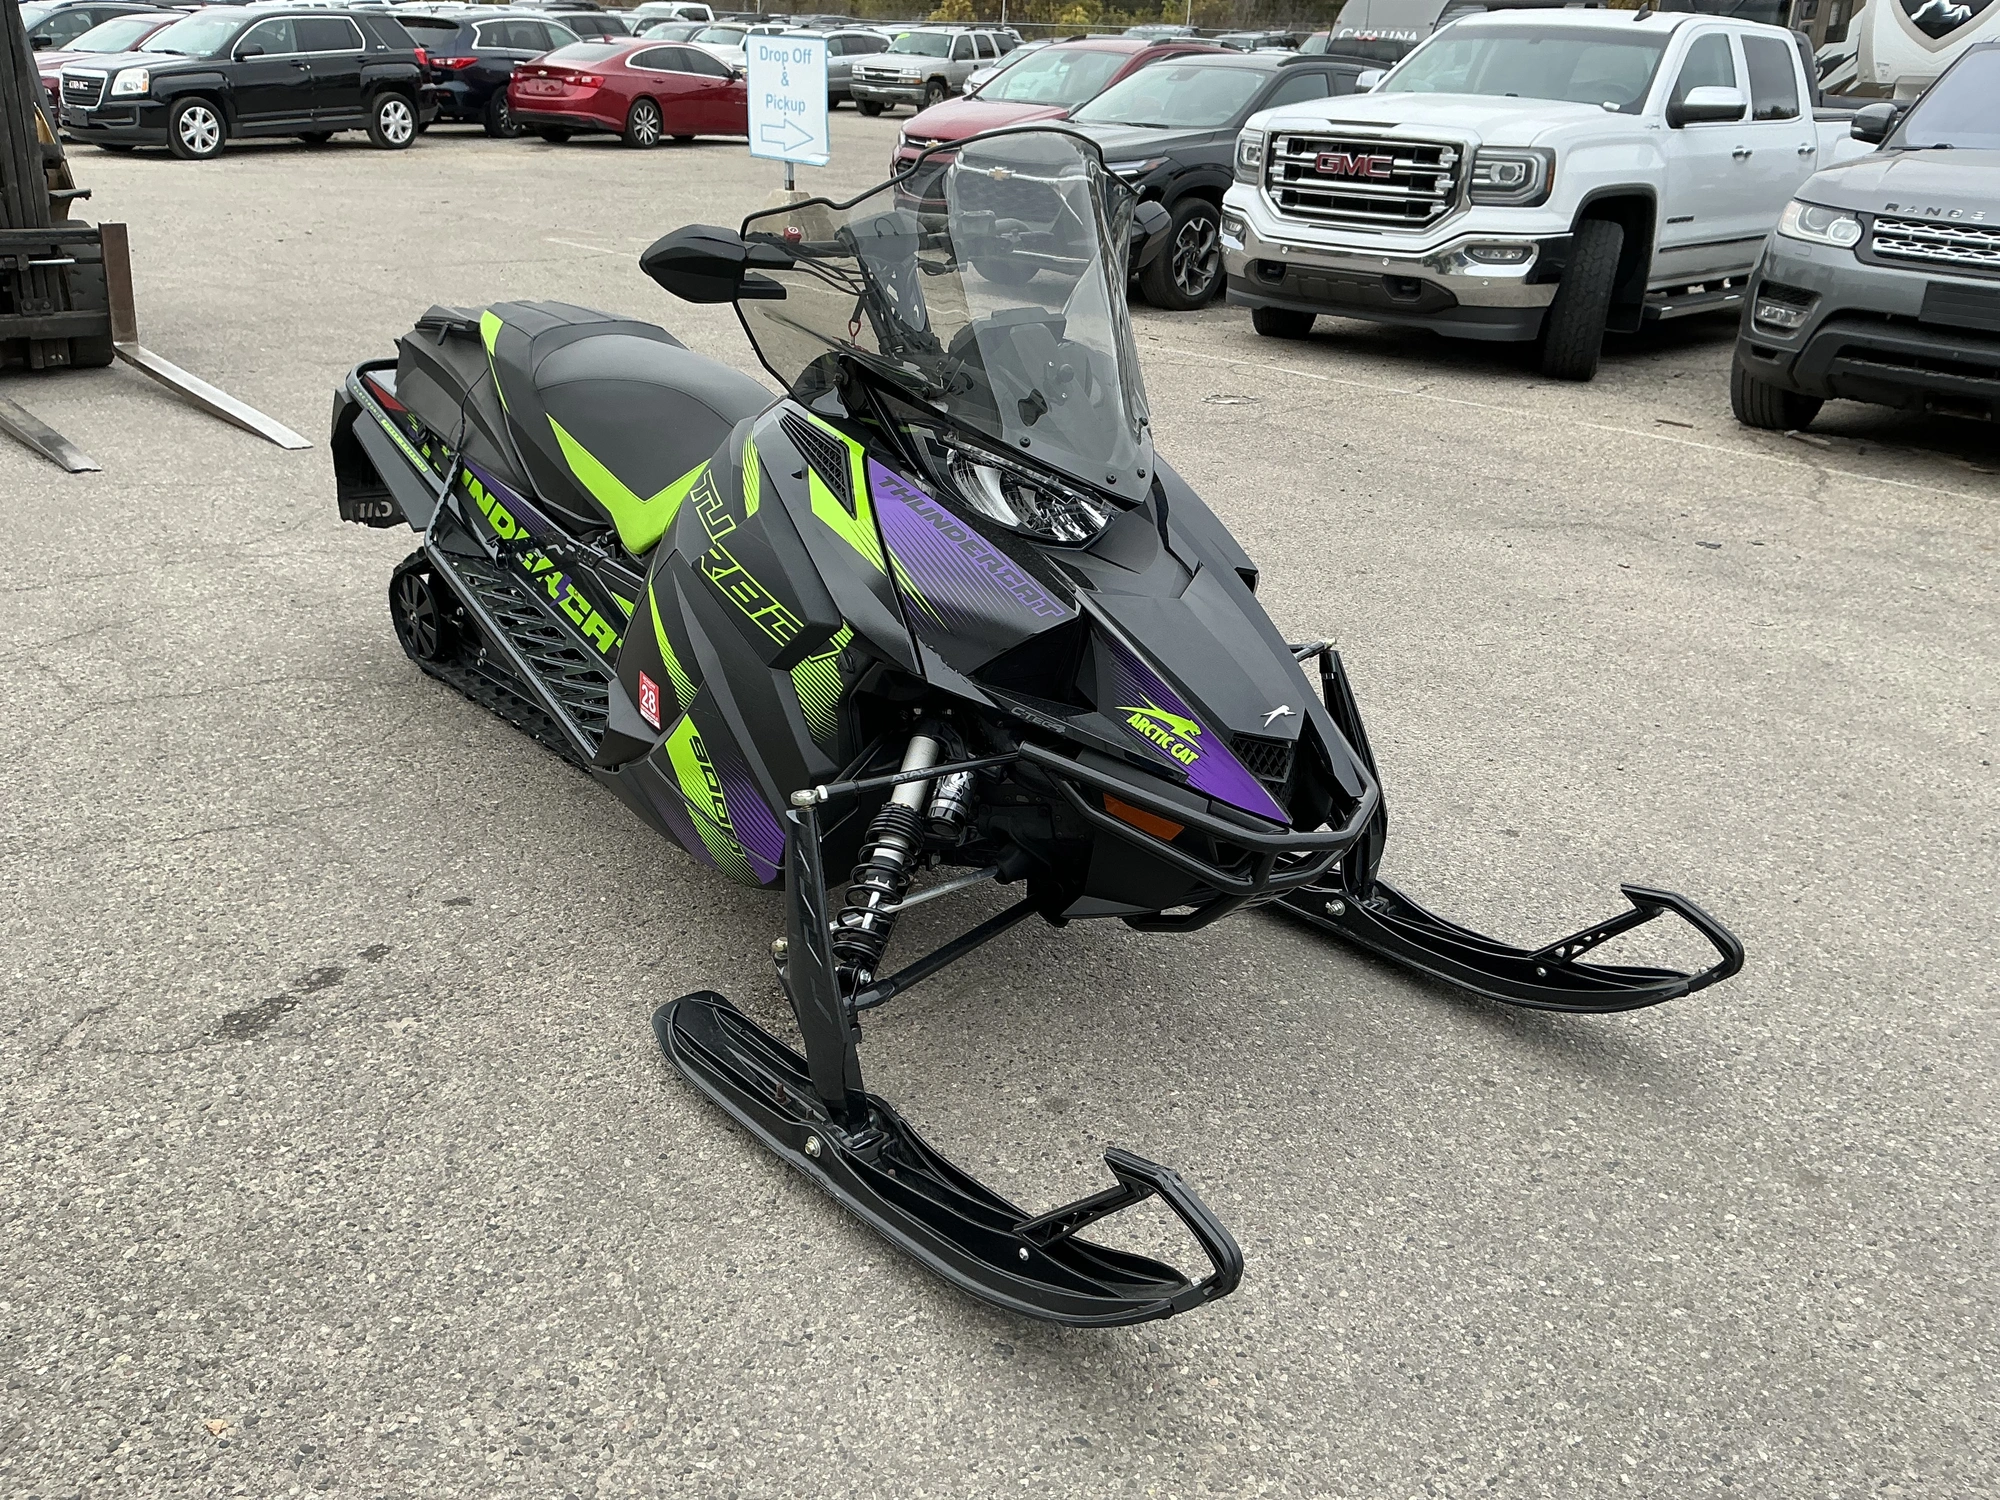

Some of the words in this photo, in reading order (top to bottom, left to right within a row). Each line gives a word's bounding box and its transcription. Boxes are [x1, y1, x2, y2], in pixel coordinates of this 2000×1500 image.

[1339, 28, 1418, 40] CATALINA
[759, 45, 790, 66] Drop
[792, 48, 812, 65] Off
[781, 71, 790, 87] &
[765, 93, 806, 115] Pickup
[1315, 151, 1393, 178] GMC
[1885, 202, 1987, 221] RANGE
[879, 475, 1066, 617] THUNDERCAT
[641, 683, 657, 714] 28
[1126, 712, 1175, 750] ARCTIC
[1170, 742, 1200, 766] CAT
[689, 733, 747, 858] 9000
